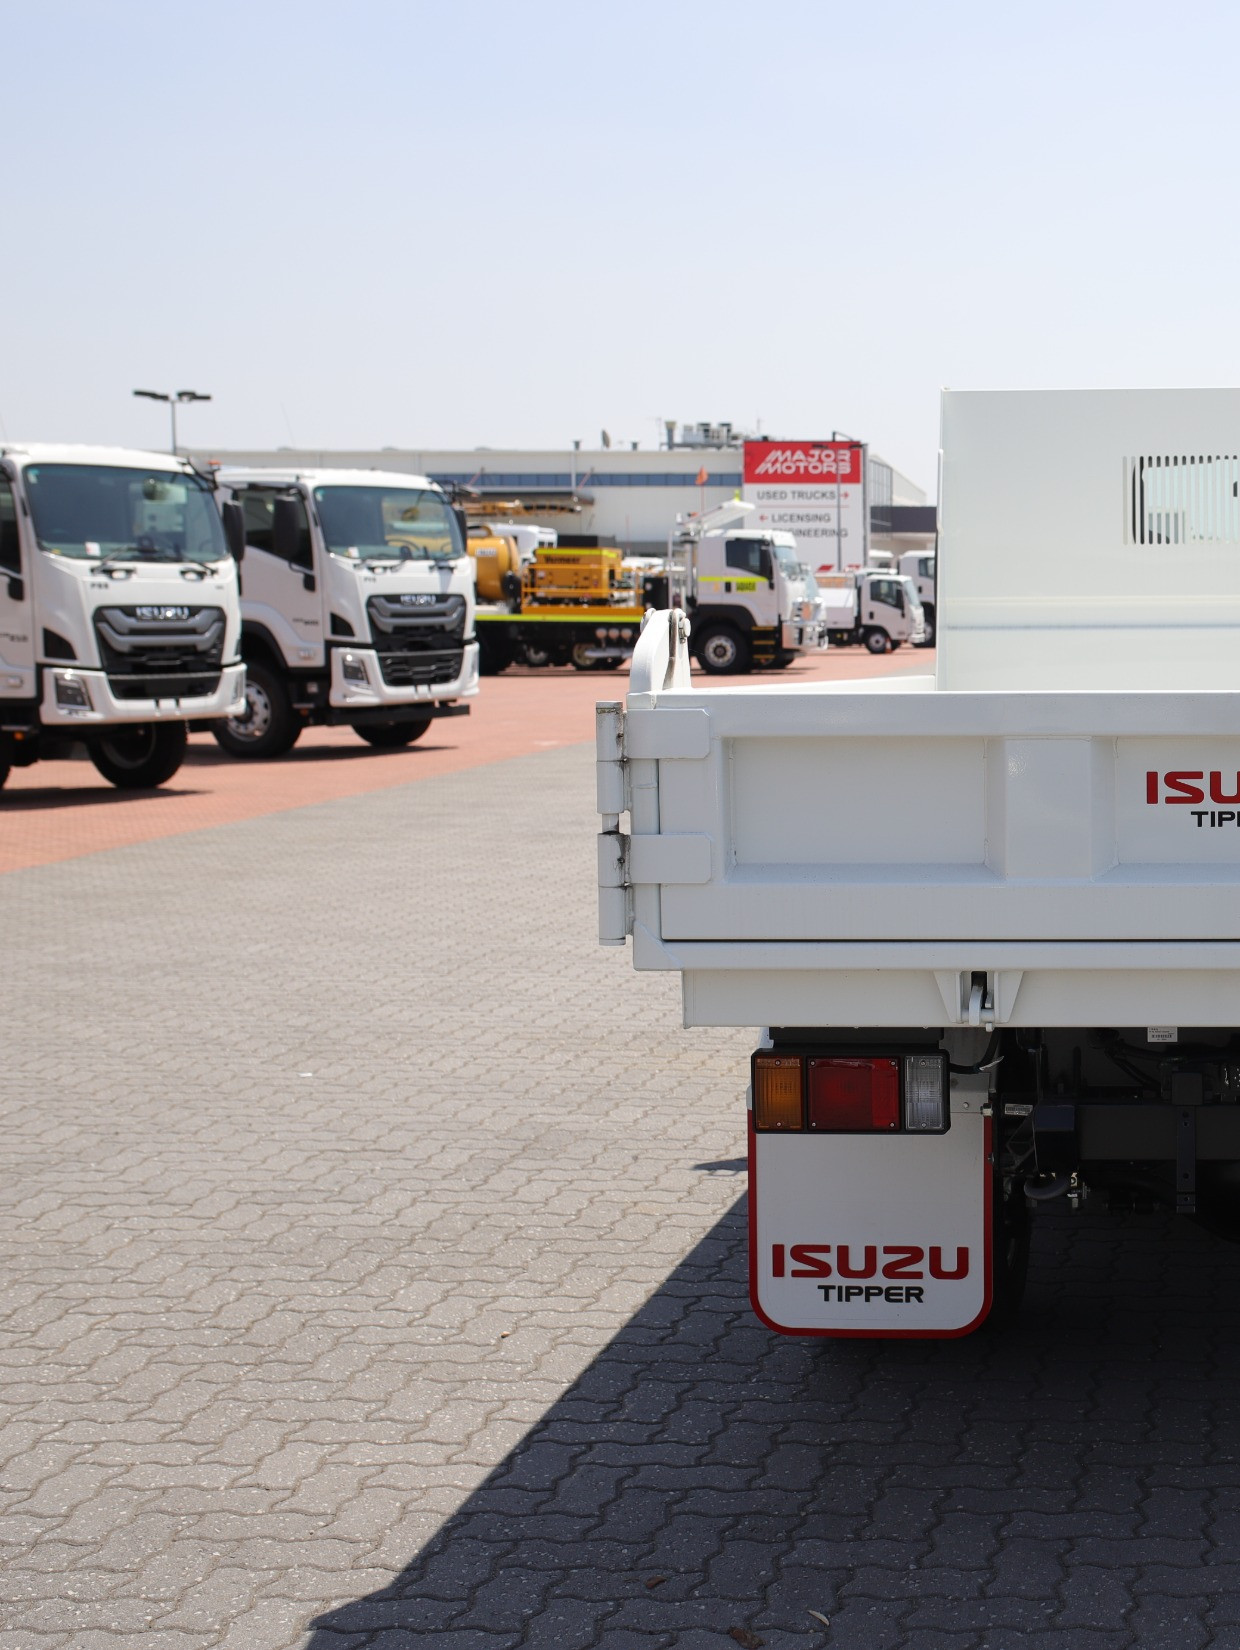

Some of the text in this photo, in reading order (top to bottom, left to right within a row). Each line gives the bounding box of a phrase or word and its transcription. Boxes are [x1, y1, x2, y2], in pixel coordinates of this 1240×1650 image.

[762, 449, 851, 462] MAJOR
[754, 461, 851, 474] MOTORS
[757, 490, 836, 500] USED TRUCKS
[772, 513, 831, 523] LICENSING
[136, 606, 190, 619] ISUZU
[772, 1244, 969, 1280] ISUZU
[817, 1285, 924, 1303] TIPPER
